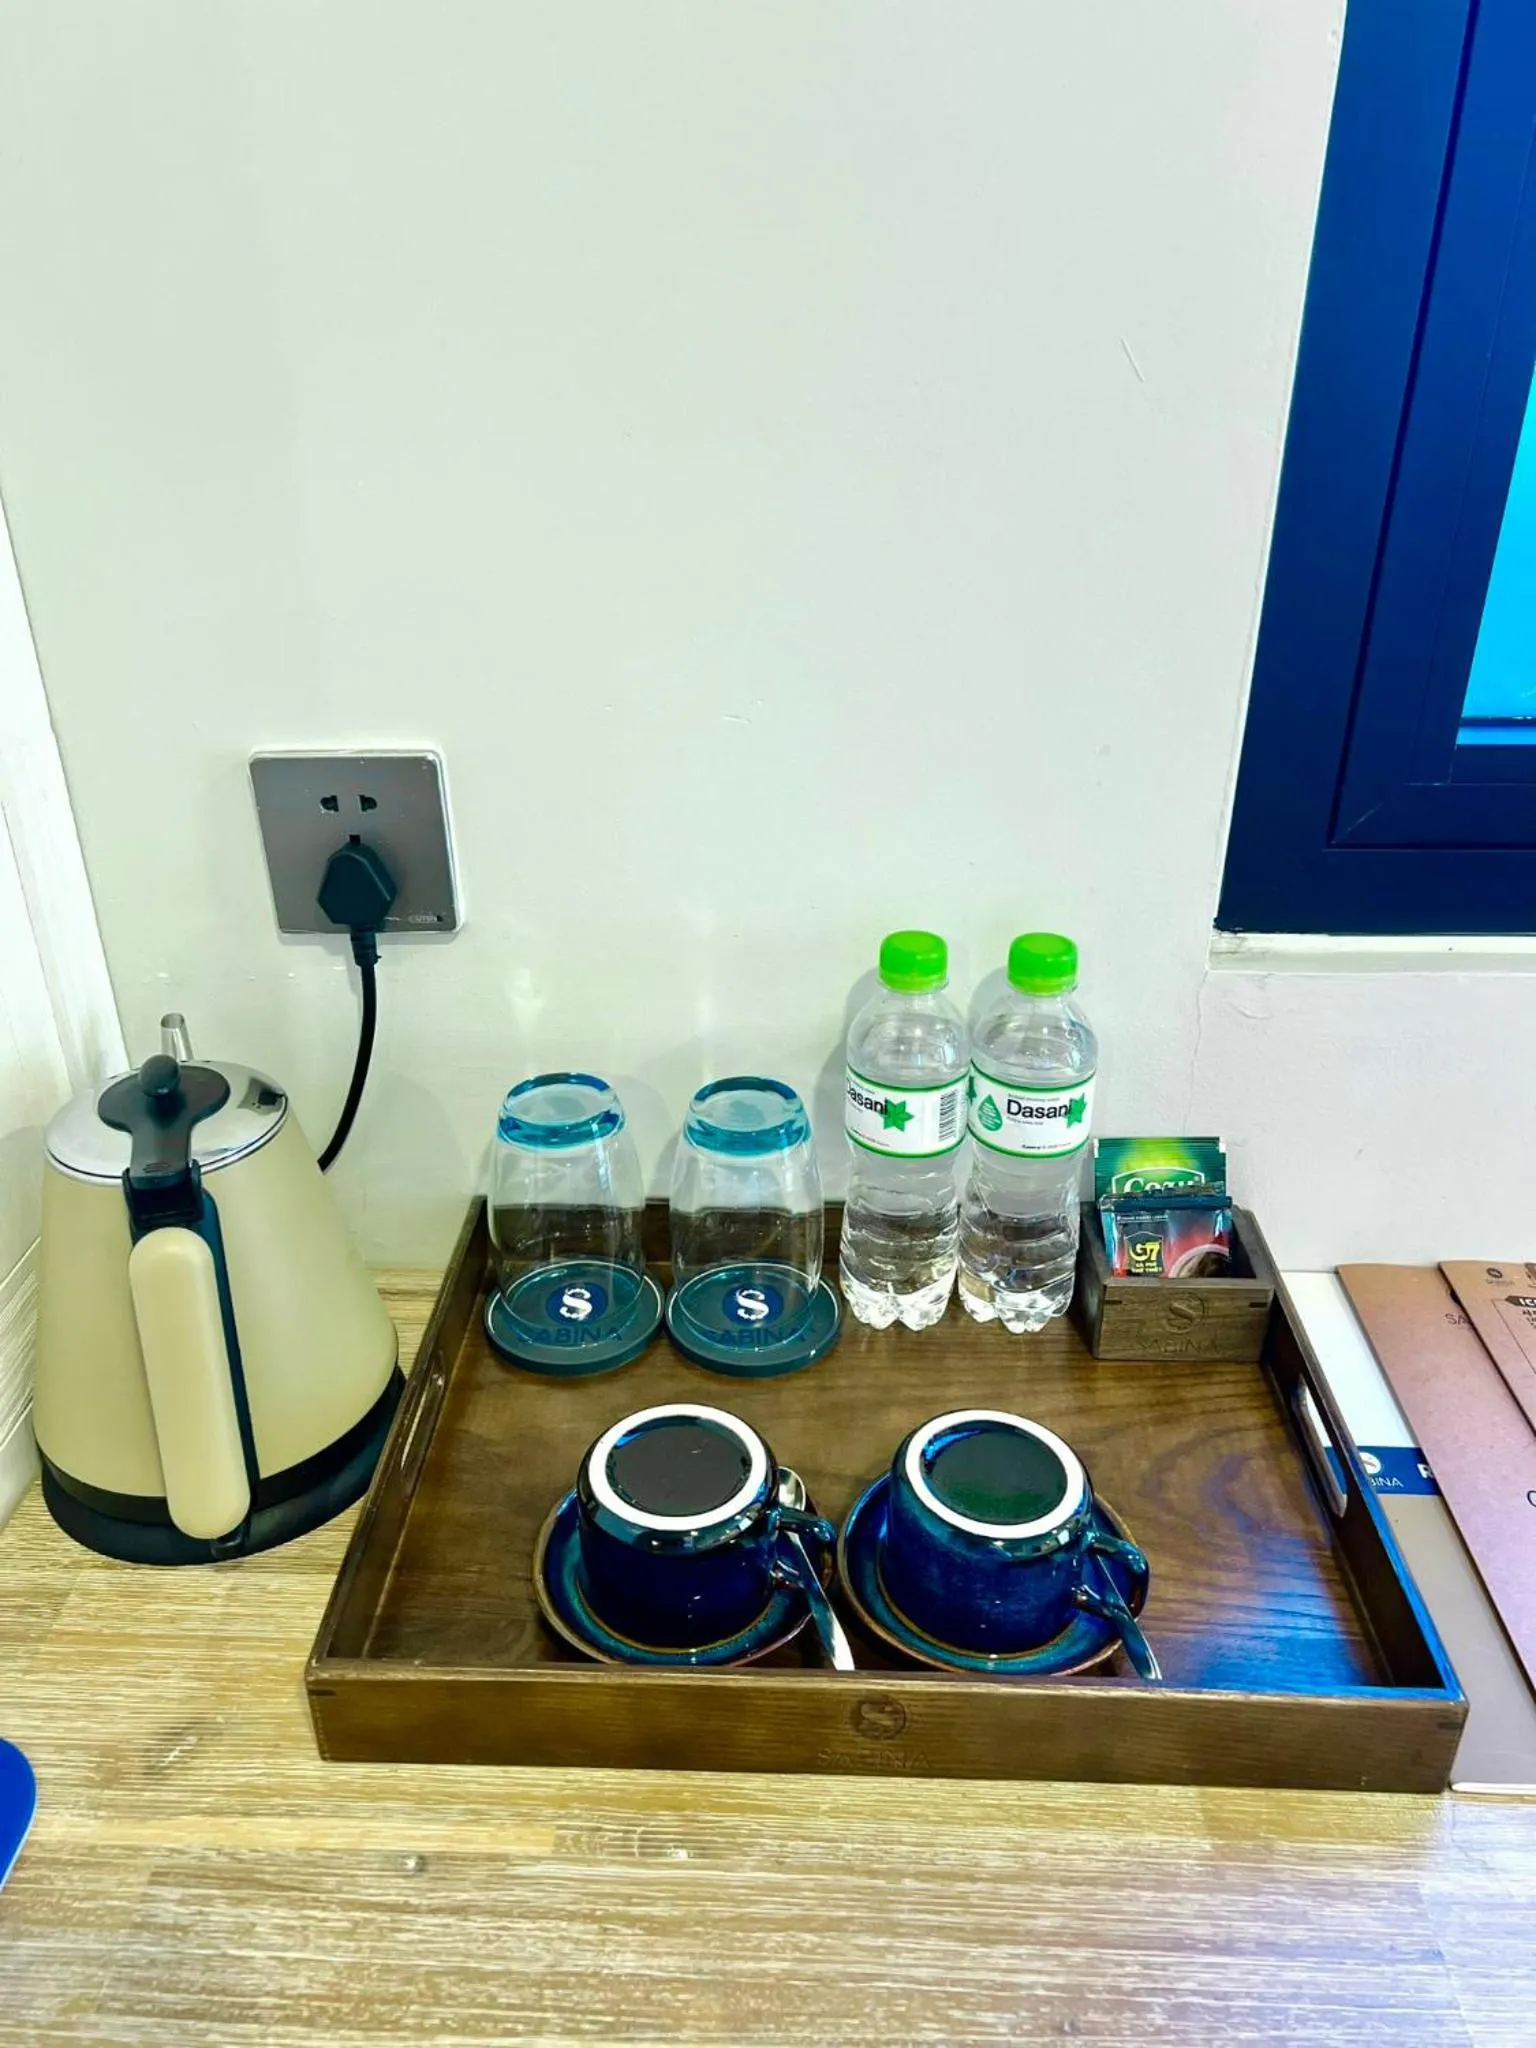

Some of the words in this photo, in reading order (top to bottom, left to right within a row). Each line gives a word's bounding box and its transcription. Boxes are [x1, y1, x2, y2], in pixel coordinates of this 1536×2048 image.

[1129, 1241, 1161, 1262] G7
[516, 1325, 624, 1347] SABINA
[703, 1325, 816, 1347] SABINA
